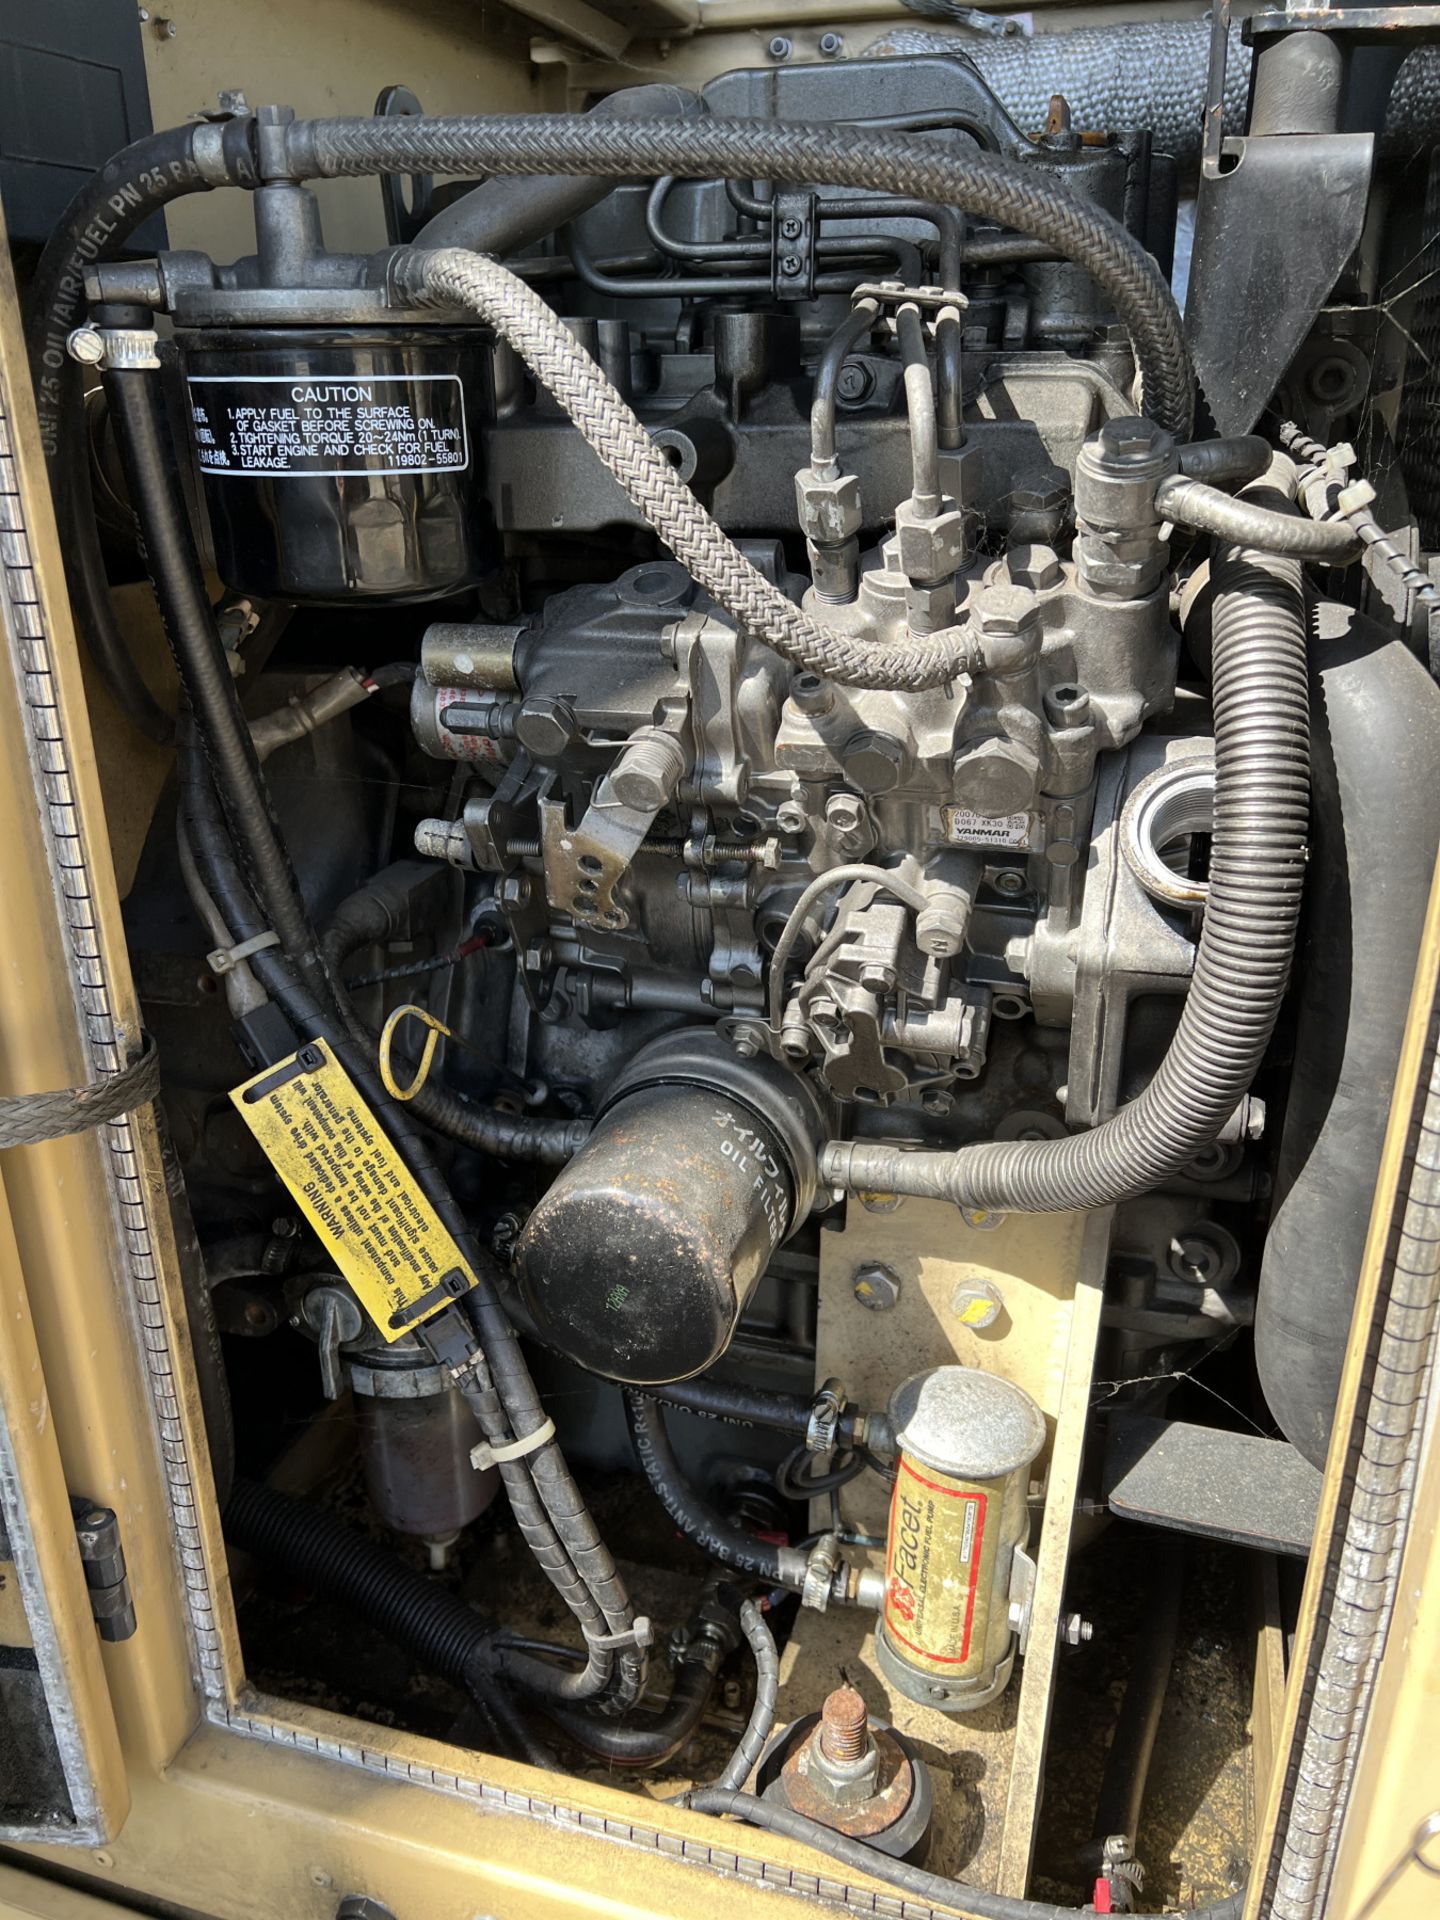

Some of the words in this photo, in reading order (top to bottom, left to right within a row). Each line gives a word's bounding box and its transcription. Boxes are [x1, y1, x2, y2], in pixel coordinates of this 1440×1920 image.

[108, 182, 143, 217] PN
[140, 166, 168, 191] 25
[291, 386, 372, 402] CAUTION
[270, 408, 300, 420] FUEL
[304, 407, 322, 419] TO
[327, 407, 352, 419] THE
[357, 406, 411, 418] SURFACE
[236, 420, 249, 432] OF
[253, 420, 296, 432] GASKET
[301, 420, 350, 432] BEFORE
[354, 419, 415, 431] SCREWING
[418, 418, 435, 430] ON.
[277, 444, 319, 456] ENGINE
[324, 444, 349, 456] AND
[353, 443, 394, 455] CHECK
[398, 442, 421, 454] FOR
[424, 441, 449, 453] FUEL
[303, 432, 354, 444] TORQUE
[241, 456, 291, 468] LEAKAGE.
[388, 452, 462, 467] 119802-55801
[956, 828, 1010, 837] YANMAR
[291, 1079, 307, 1095] will
[269, 1094, 292, 1124] system
[311, 1081, 345, 1124] generator
[302, 1096, 335, 1140] component
[346, 1106, 373, 1145] systems.
[290, 1126, 307, 1149] drive
[301, 1118, 319, 1141] with.
[341, 1127, 354, 1144] the
[333, 1141, 347, 1159] this
[353, 1146, 363, 1157] to
[369, 1148, 387, 1168] fuel
[303, 1151, 335, 1193] dedicated
[314, 1143, 348, 1187] tampered
[342, 1160, 354, 1169] of
[352, 1170, 371, 1197] wiring
[362, 1159, 387, 1195] damage
[383, 1170, 400, 1187] and
[347, 1189, 359, 1203] be
[720, 1140, 746, 1173] OIL
[753, 1175, 777, 1247] FILTER
[302, 1181, 345, 1239] WARNING
[355, 1204, 371, 1220] not
[369, 1198, 381, 1213] the
[397, 1190, 428, 1232] electrical
[340, 1205, 363, 1236] utilises
[377, 1214, 389, 1223] of
[385, 1197, 419, 1244] significant
[367, 1222, 387, 1247] must
[383, 1249, 400, 1267] and
[387, 1224, 421, 1272] modification
[360, 1238, 394, 1284] component
[418, 1246, 438, 1273] cause
[418, 1273, 432, 1290] Any
[393, 1287, 408, 1307] This
[637, 1438, 697, 1533] ANTI-STATIC
[696, 1530, 730, 1561] BAR
[892, 1495, 921, 1588] Facet
[920, 1545, 929, 1593] ELECTRONIC
[926, 1499, 934, 1523] PUMP
[735, 1553, 755, 1571] 25
[760, 1562, 784, 1581] PN
